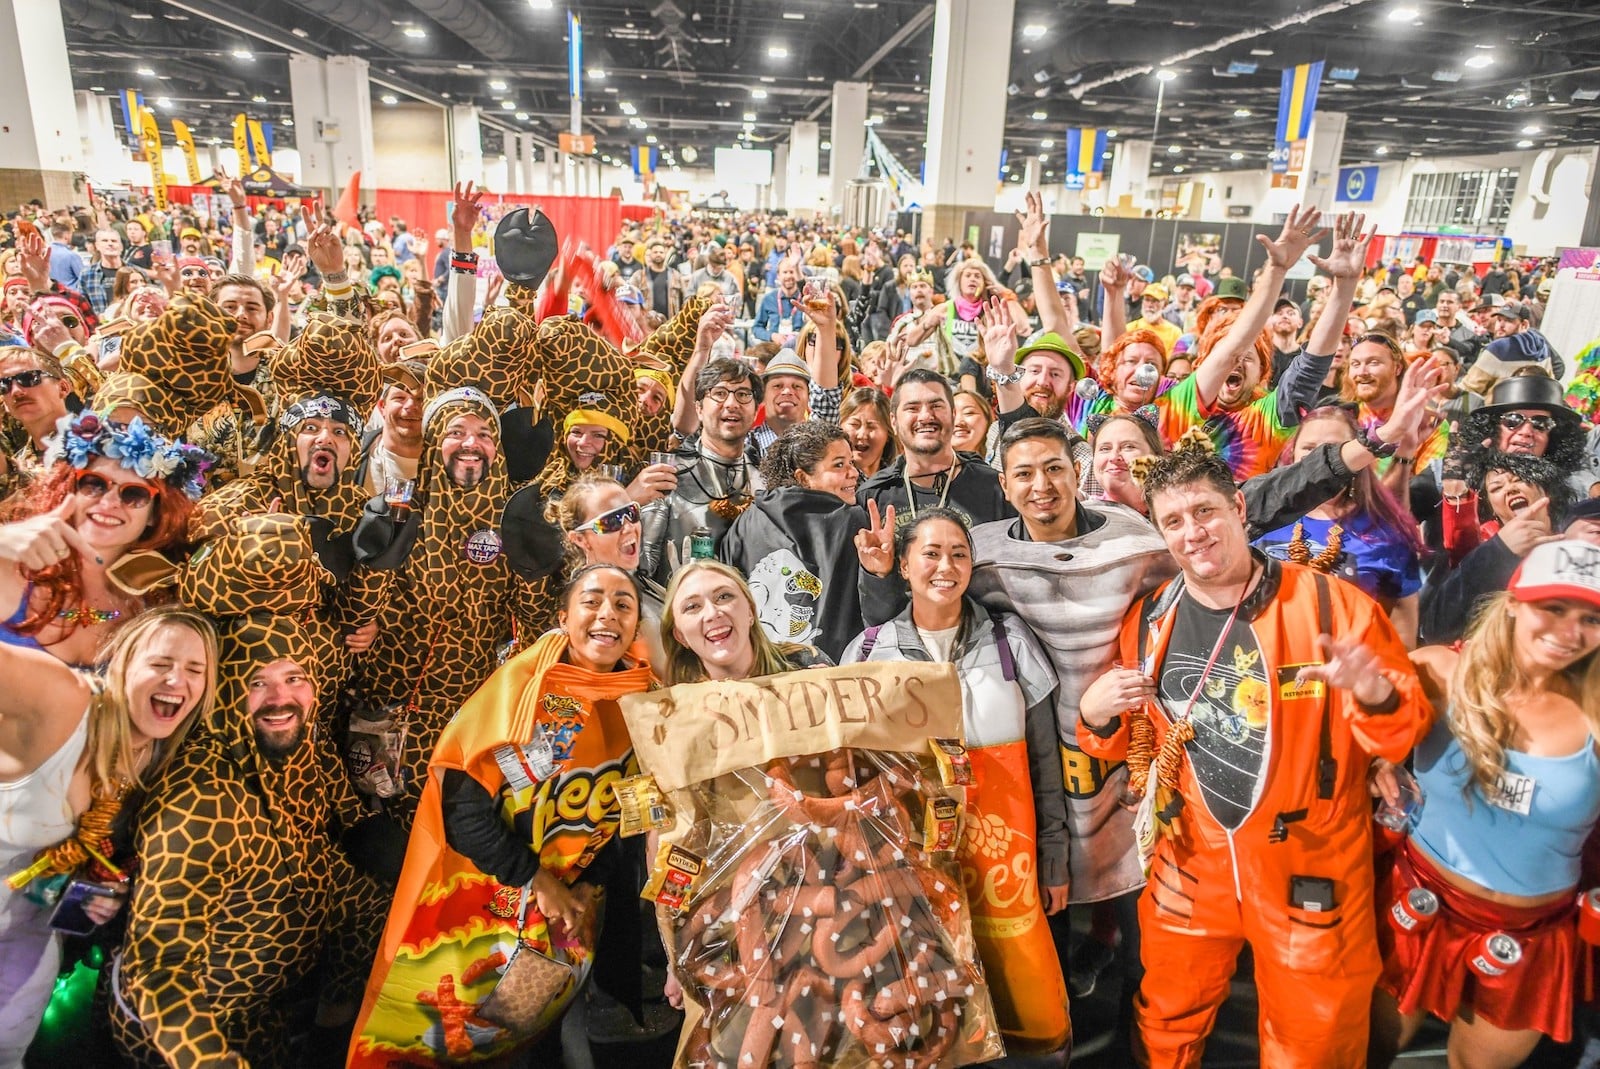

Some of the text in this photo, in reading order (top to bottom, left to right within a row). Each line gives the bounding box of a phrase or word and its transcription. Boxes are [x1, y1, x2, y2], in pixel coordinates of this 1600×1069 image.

[467, 543, 482, 551] MAX
[701, 676, 928, 750] SNYDER'S
[1495, 773, 1531, 804] Duff
